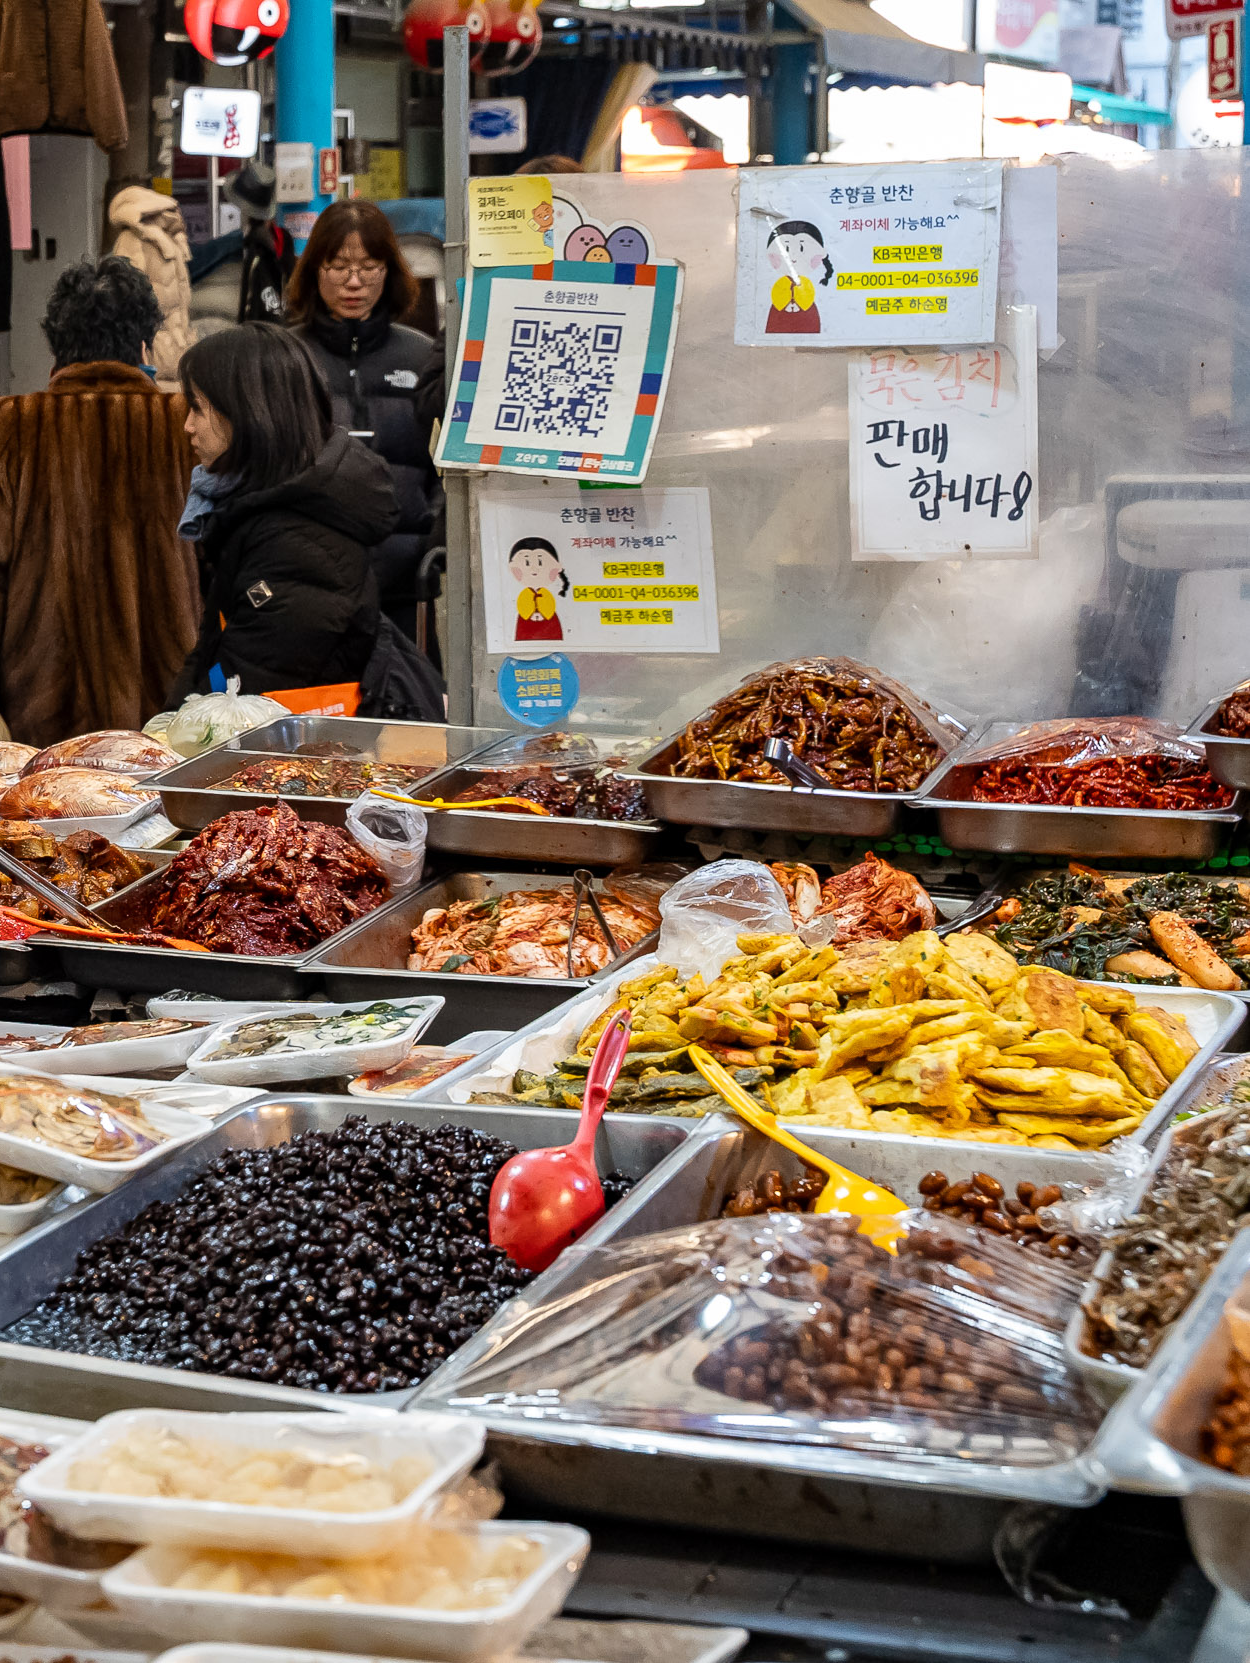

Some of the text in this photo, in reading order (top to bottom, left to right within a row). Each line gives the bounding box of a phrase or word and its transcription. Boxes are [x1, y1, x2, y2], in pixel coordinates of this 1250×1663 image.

[829, 184, 914, 205] 춘향골 반찬
[477, 209, 526, 221] 카카오페이
[839, 218, 890, 232] 계좌이체
[873, 246, 943, 261] KB국민은행
[836, 271, 979, 287] 04-0001-04-036396
[544, 290, 598, 305] 춘향골반찬
[866, 297, 948, 312] 예금주 하순영
[866, 350, 1000, 408] 묵은 김치
[866, 420, 948, 468] 판매
[515, 453, 548, 465] zero
[560, 506, 636, 523] 춘향골 반찬
[571, 537, 616, 549] 계좌이체
[603, 563, 664, 576] KB국민은행
[573, 587, 699, 599] 04-0001-04-036396
[600, 610, 673, 623] 예금주 하순영
[516, 684, 562, 697] 소비쿠폰
